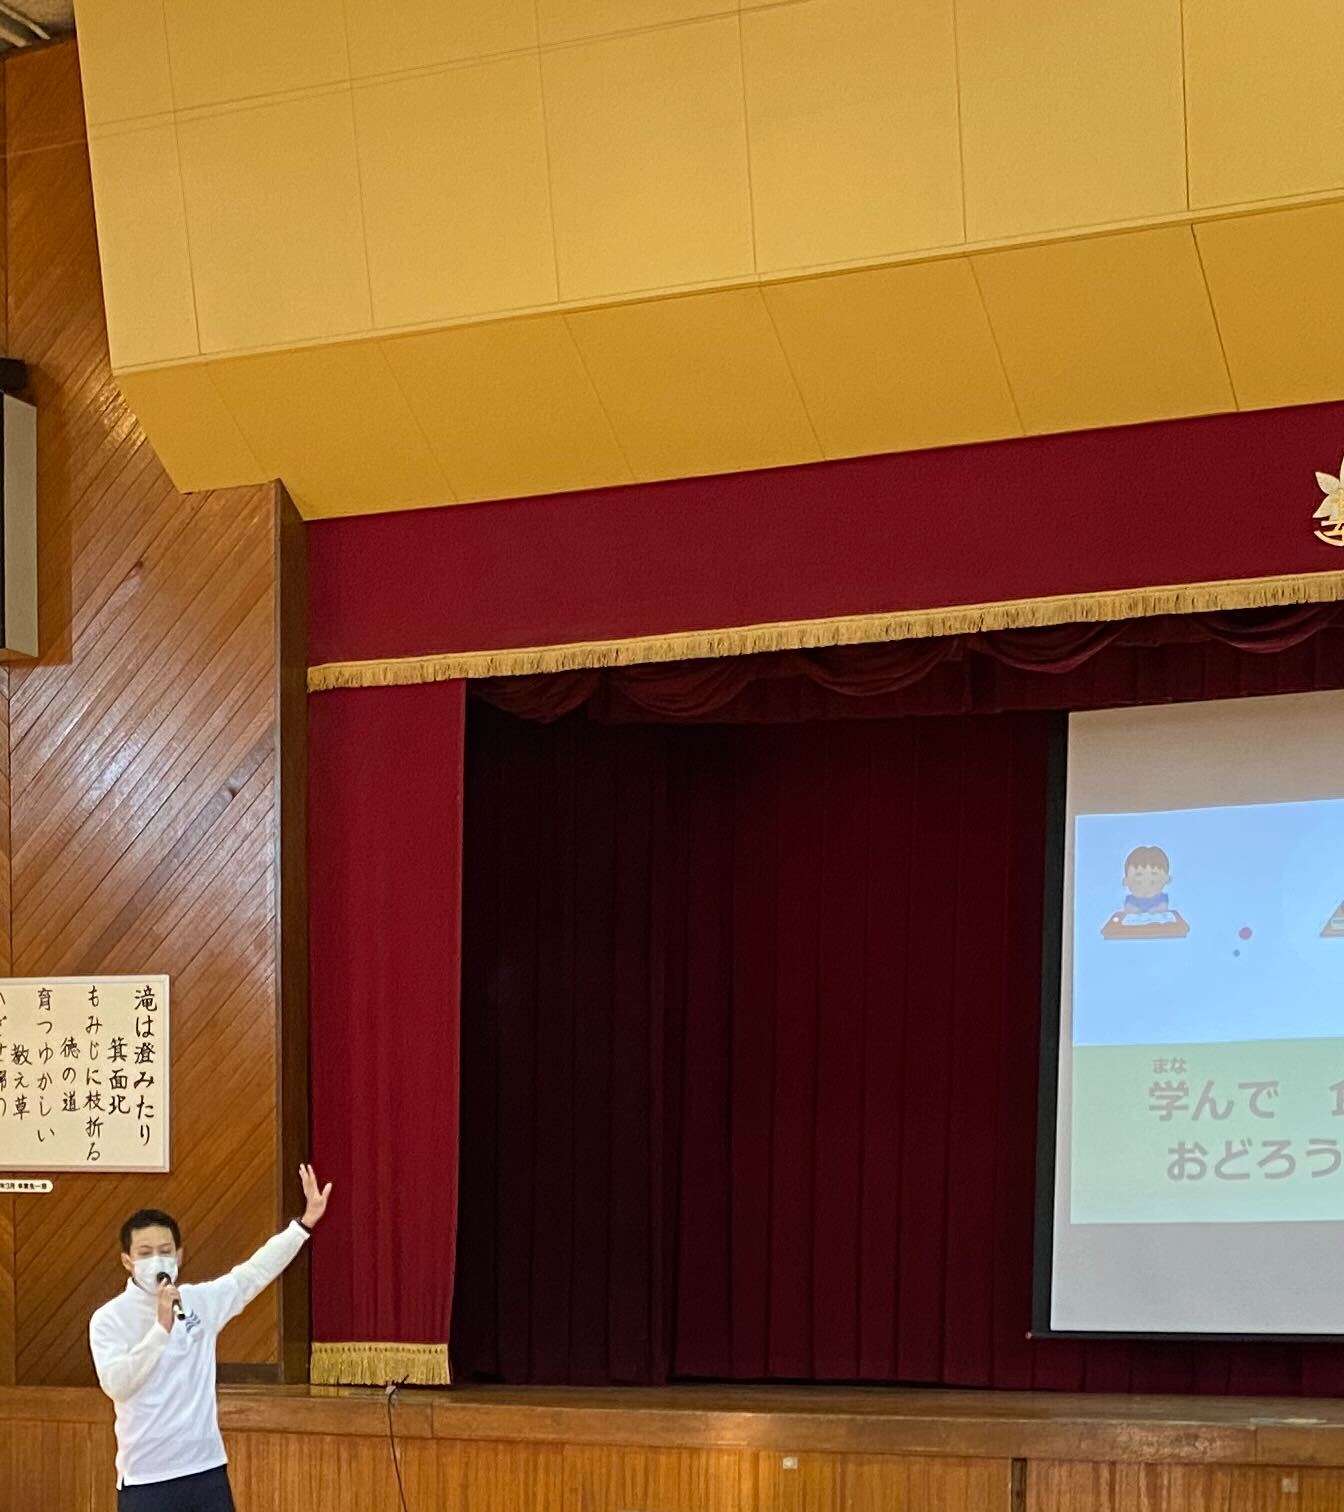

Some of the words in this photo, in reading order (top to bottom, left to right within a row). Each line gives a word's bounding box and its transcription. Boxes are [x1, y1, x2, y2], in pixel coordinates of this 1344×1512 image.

[36, 987, 55, 1143] 育つゆかしい
[59, 1036, 81, 1113] 徳の道
[83, 985, 106, 1162] もみじに枝折る
[107, 1036, 131, 1115] 箕面北
[134, 985, 158, 1146] 滝は澄みたり
[1148, 1079, 1280, 1121] 学んで
[1152, 1057, 1187, 1074] まな
[1166, 1137, 1343, 1181] おどろう
